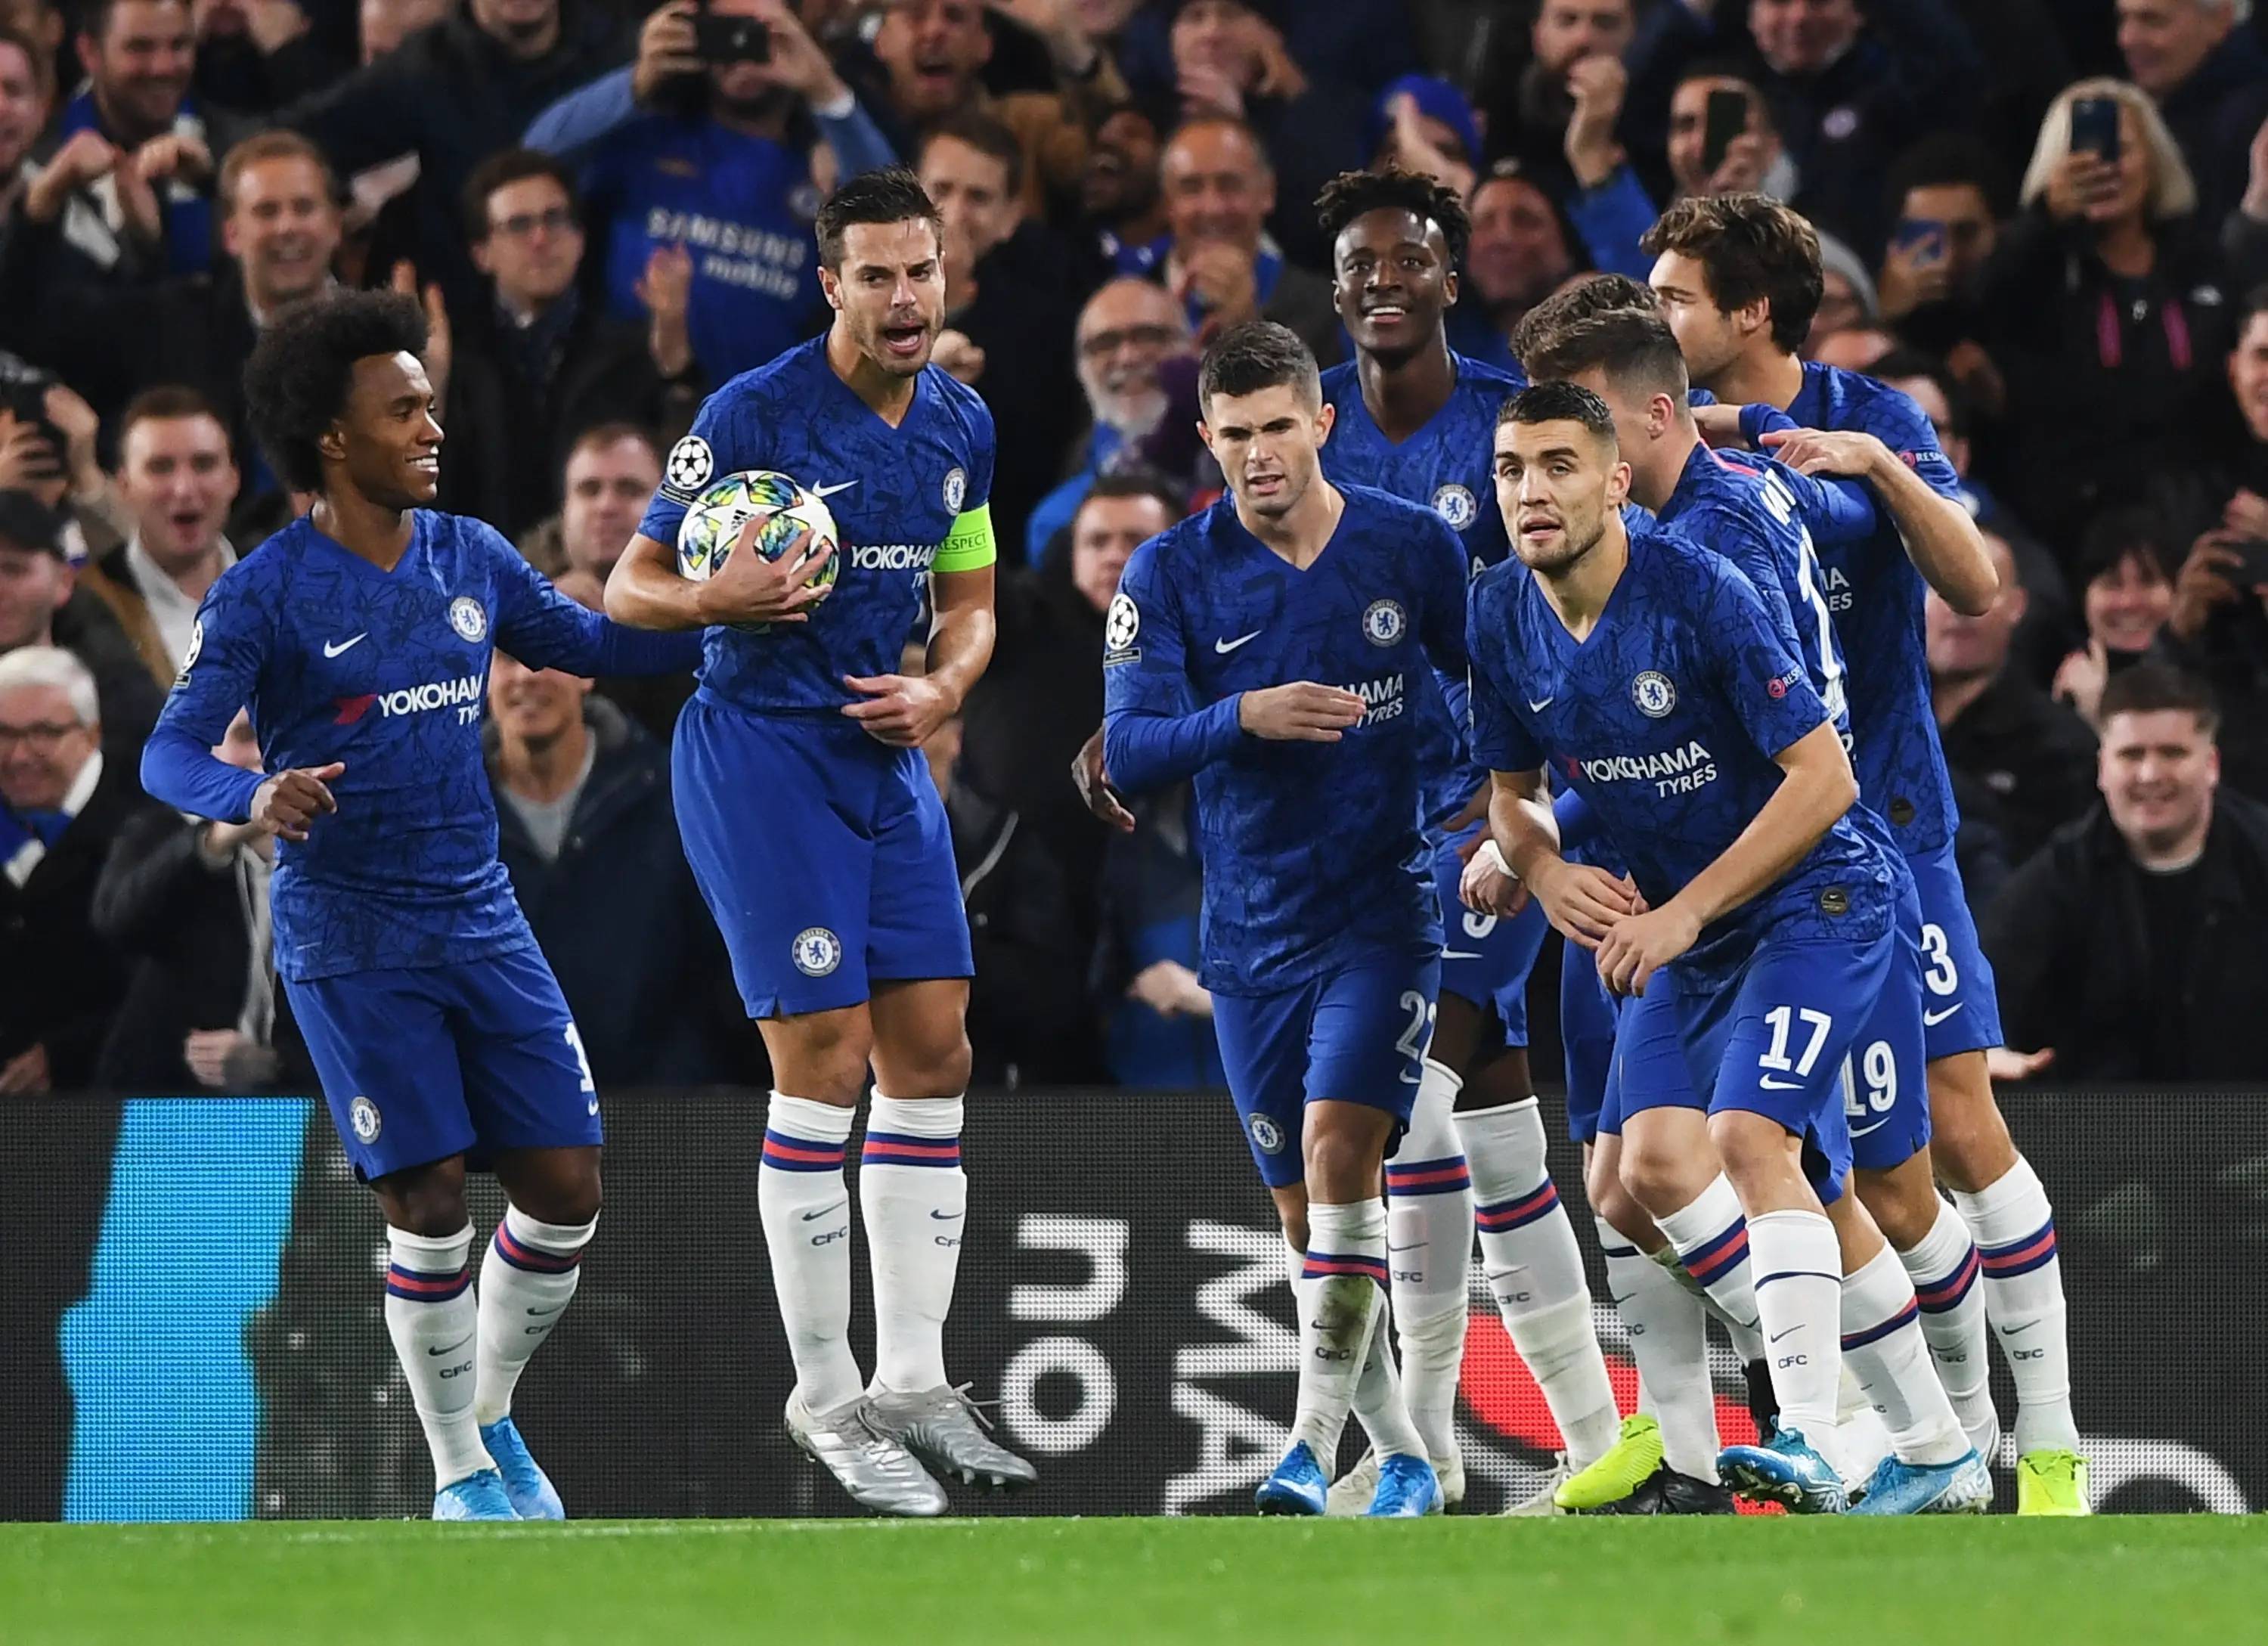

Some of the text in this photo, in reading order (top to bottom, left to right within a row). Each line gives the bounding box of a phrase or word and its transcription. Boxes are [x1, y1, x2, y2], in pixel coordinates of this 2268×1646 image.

[648, 207, 806, 268] SAMSUNG
[704, 255, 798, 299] mobile
[1656, 764, 1717, 798] TYRES
[1758, 1006, 1832, 1077] 17
[1839, 1040, 1897, 1116] 19
[1393, 1270, 1423, 1283] CFC
[1498, 1291, 1530, 1305] CFC
[439, 1360, 472, 1379] CFC
[1164, 1218, 1300, 1516] MA
[1778, 1354, 1808, 1369] CFC
[2013, 1349, 2044, 1360] CFC
